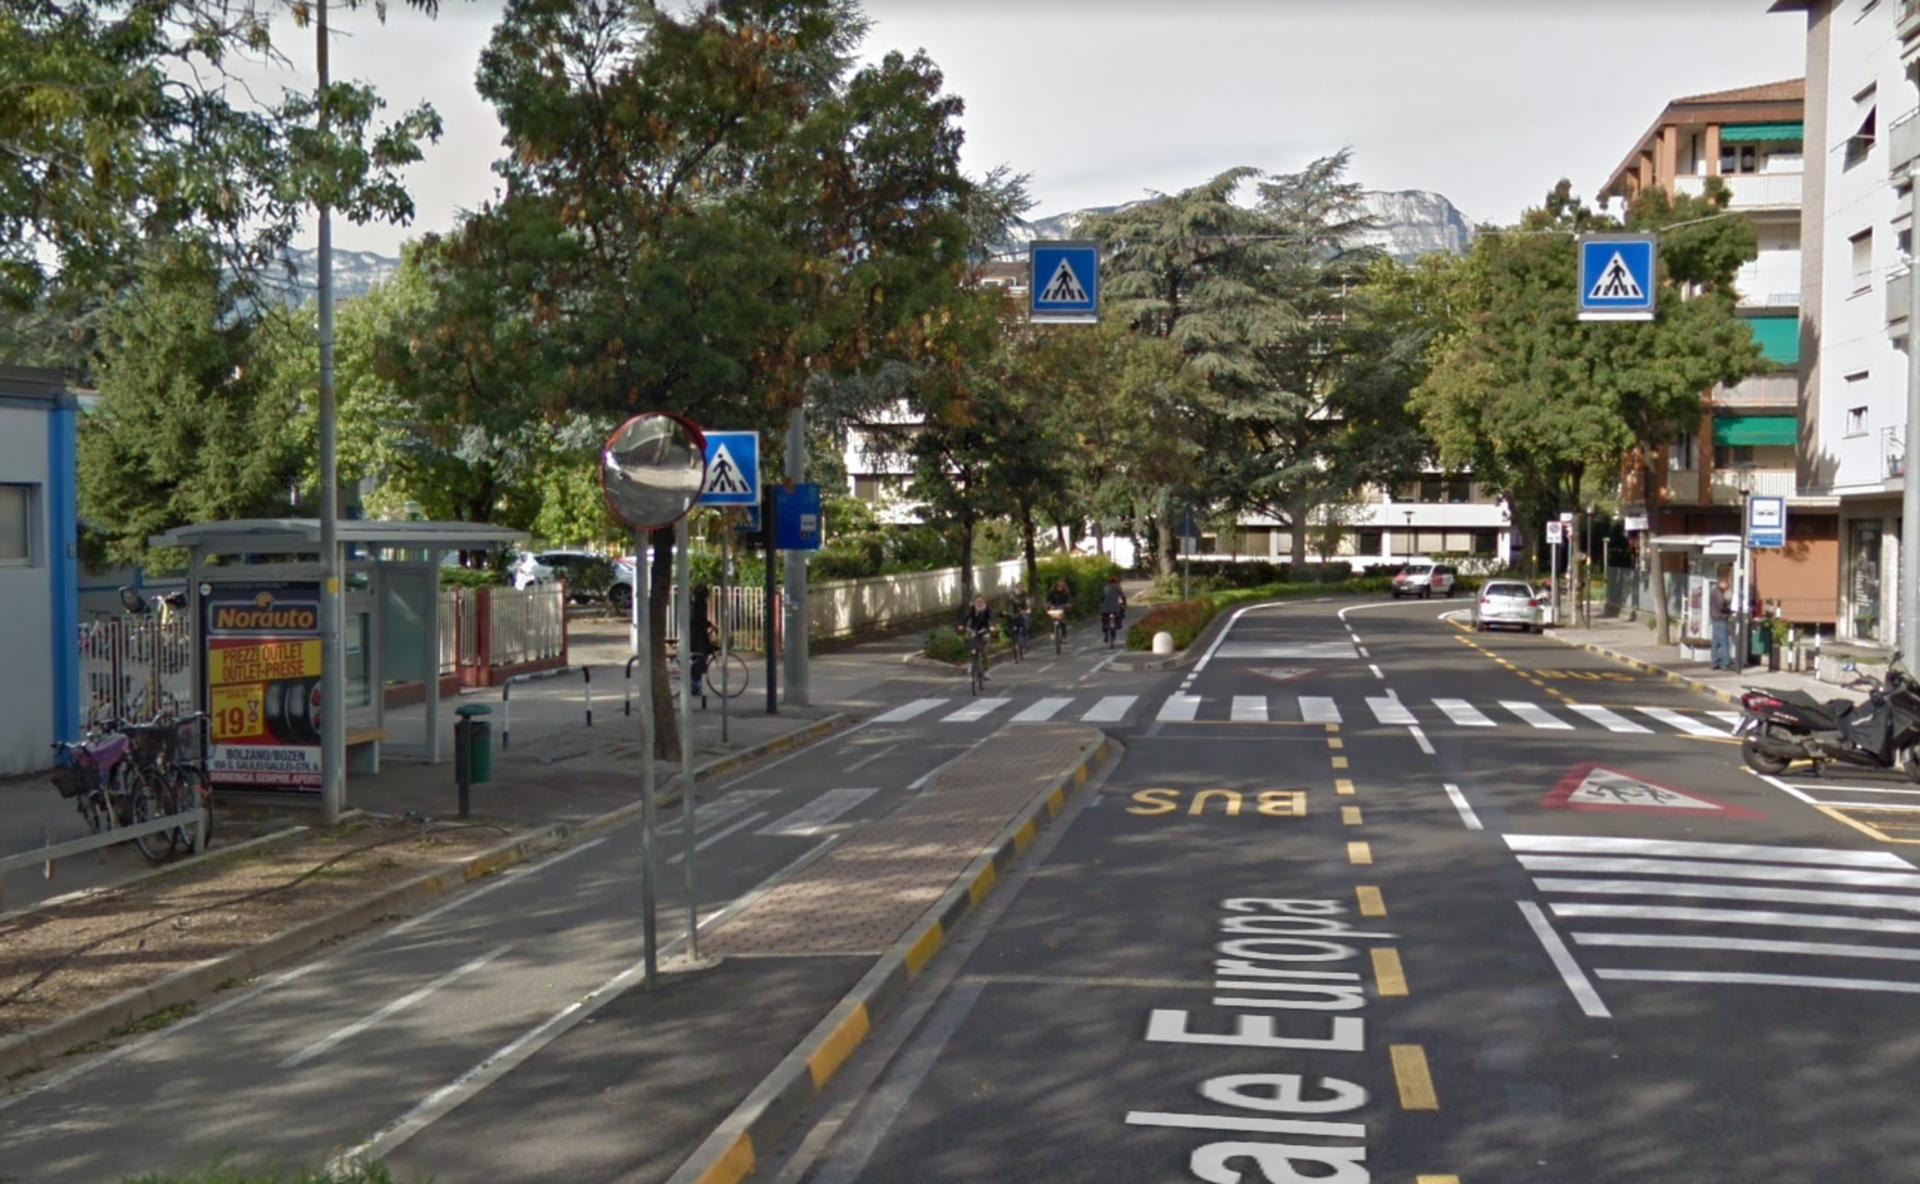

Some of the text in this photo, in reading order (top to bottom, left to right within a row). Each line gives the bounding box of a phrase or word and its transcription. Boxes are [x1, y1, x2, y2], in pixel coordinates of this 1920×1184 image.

[217, 608, 314, 628] Norauto
[223, 642, 304, 664] PREZZI OUTLET
[223, 659, 305, 682] OUTLET-PREISE
[226, 748, 306, 761] BOLZANO/BOZEN
[1125, 788, 1307, 816] BUS
